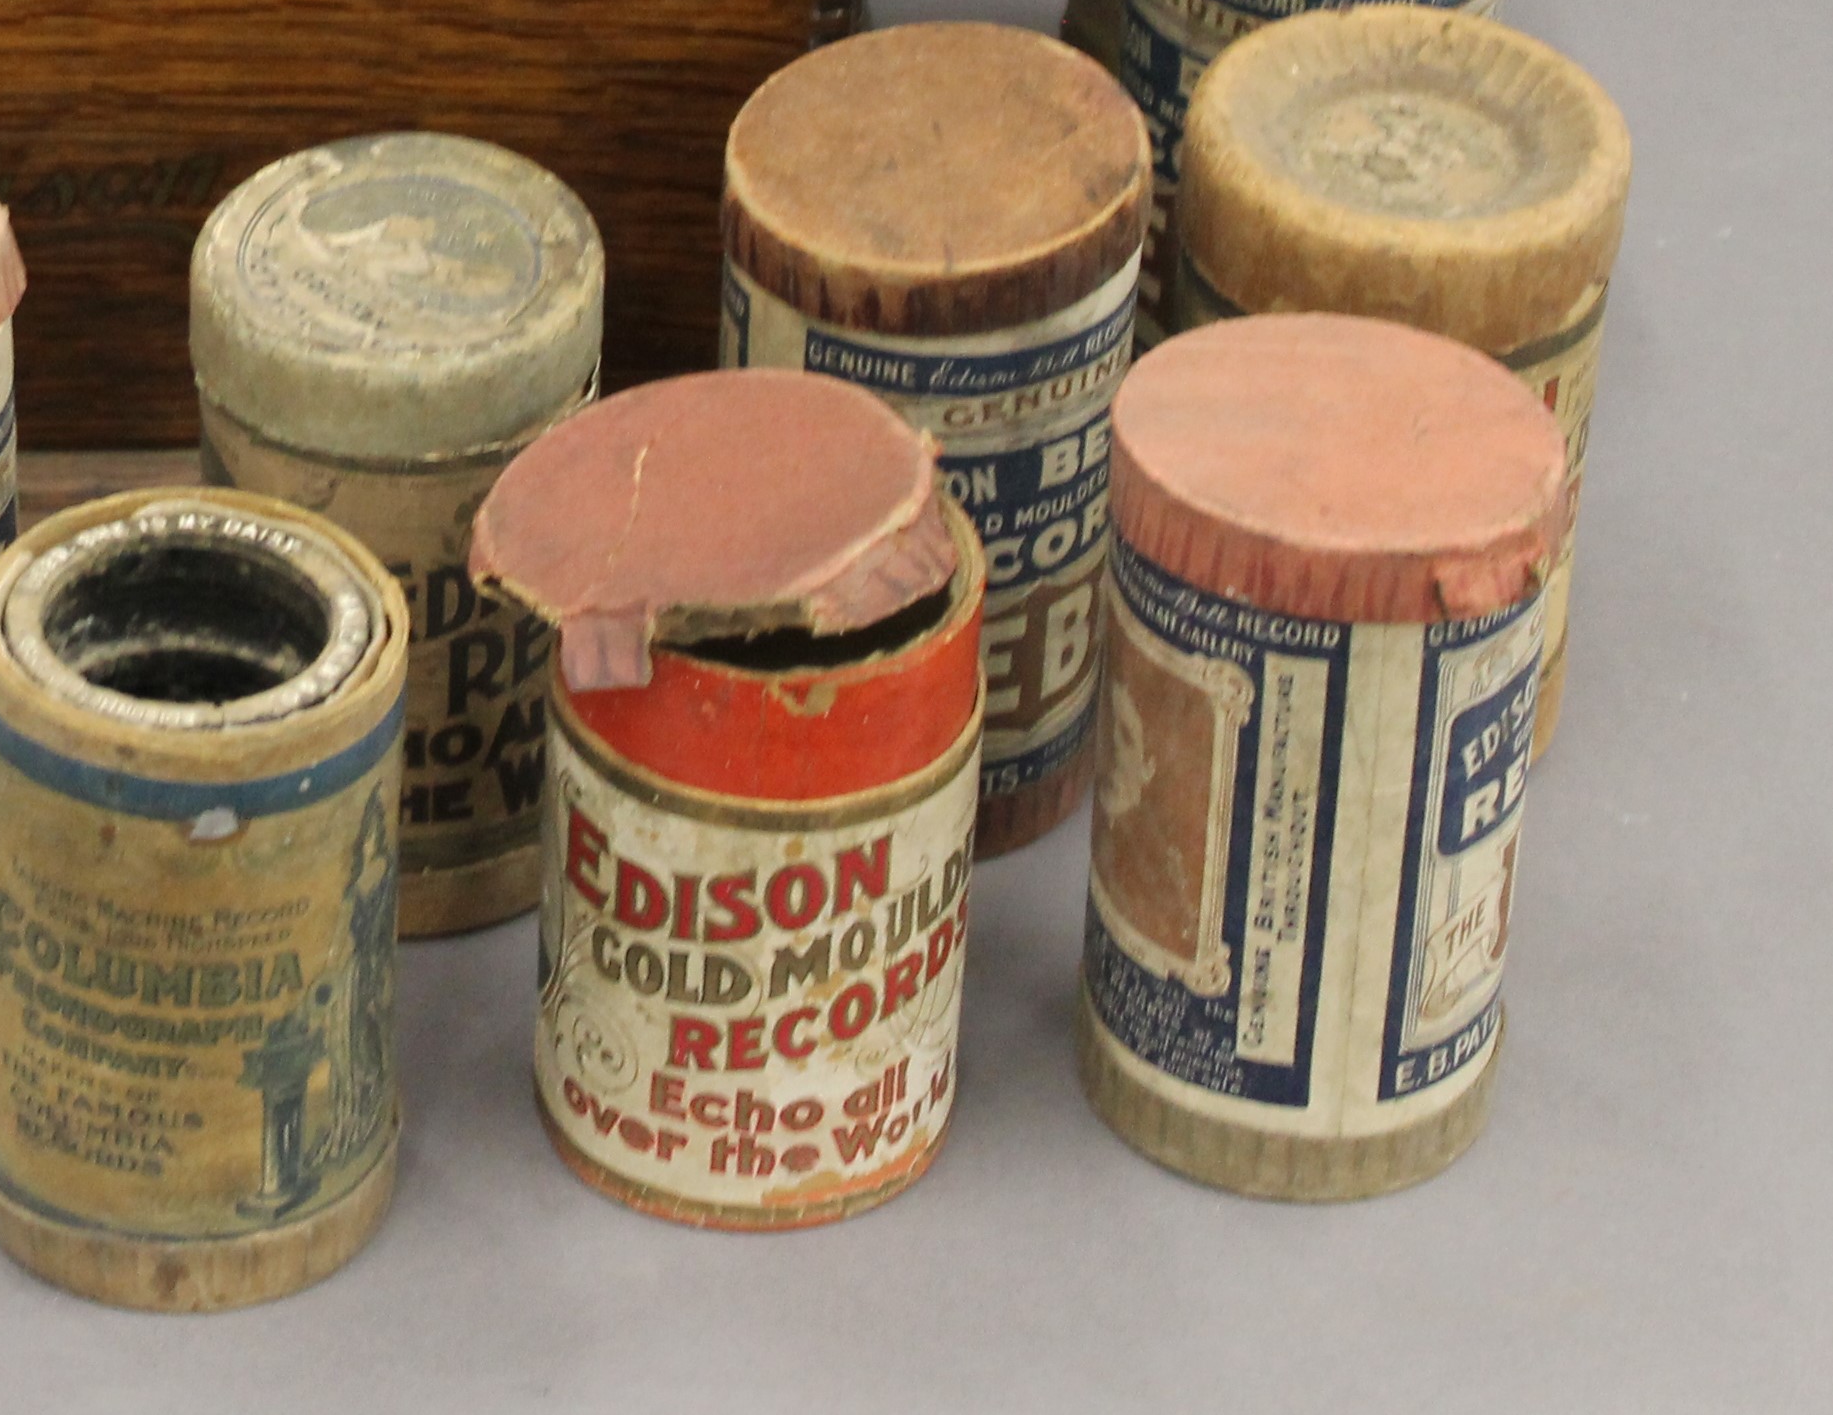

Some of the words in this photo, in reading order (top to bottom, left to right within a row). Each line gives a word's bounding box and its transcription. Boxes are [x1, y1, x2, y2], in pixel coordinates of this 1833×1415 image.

[808, 338, 917, 386] GENUINE
[1179, 618, 1256, 665] GALLERY
[1236, 610, 1342, 649] RECORD
[566, 803, 895, 943] EDISON
[1253, 829, 1281, 932] BRITISH
[592, 924, 754, 1005] GOLD
[1444, 895, 1487, 961] THE
[22, 1006, 189, 1080] COMPANY
[56, 1085, 205, 1130] FAMOUS
[564, 1075, 689, 1162] over
[709, 1133, 820, 1178] the
[649, 1070, 825, 1135] Echo
[843, 1053, 911, 1118] all
